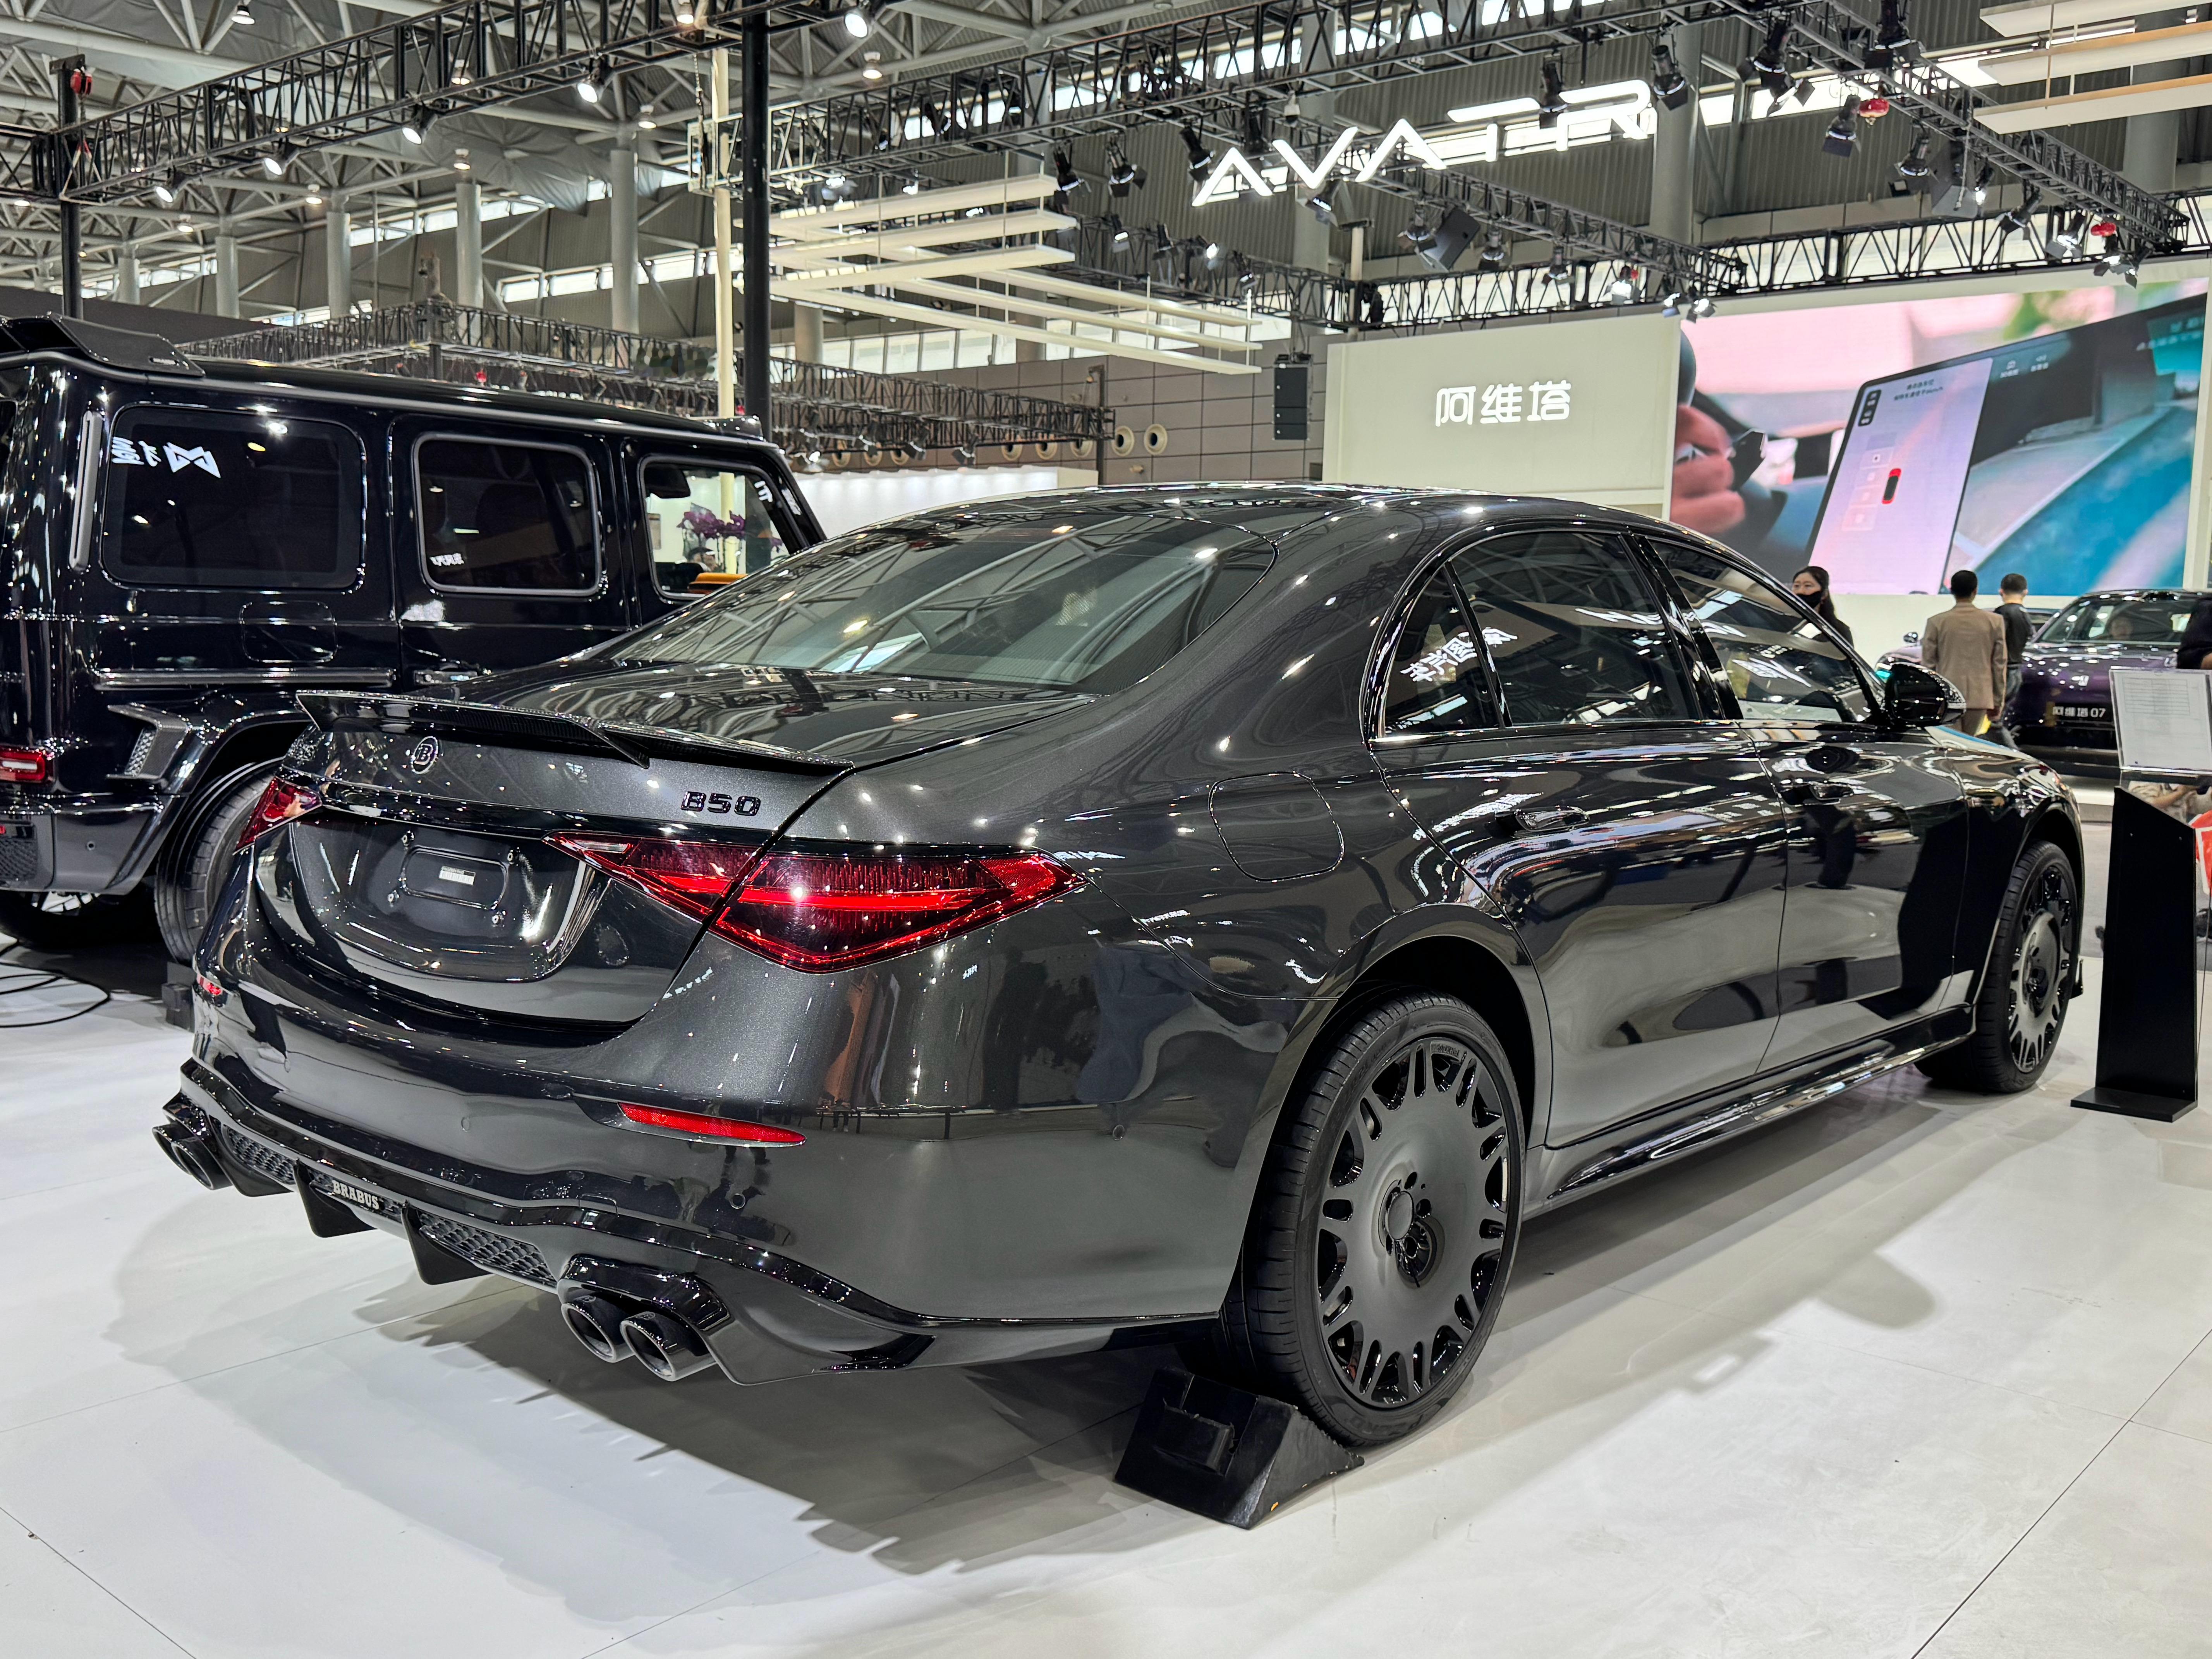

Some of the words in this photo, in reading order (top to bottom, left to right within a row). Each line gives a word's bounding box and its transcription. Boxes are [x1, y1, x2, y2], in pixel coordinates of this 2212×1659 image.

[1192, 79, 1651, 207] AVATR
[1435, 380, 1571, 427] 阿维塔
[680, 791, 761, 816] B50
[332, 1180, 379, 1210] BRABUS
